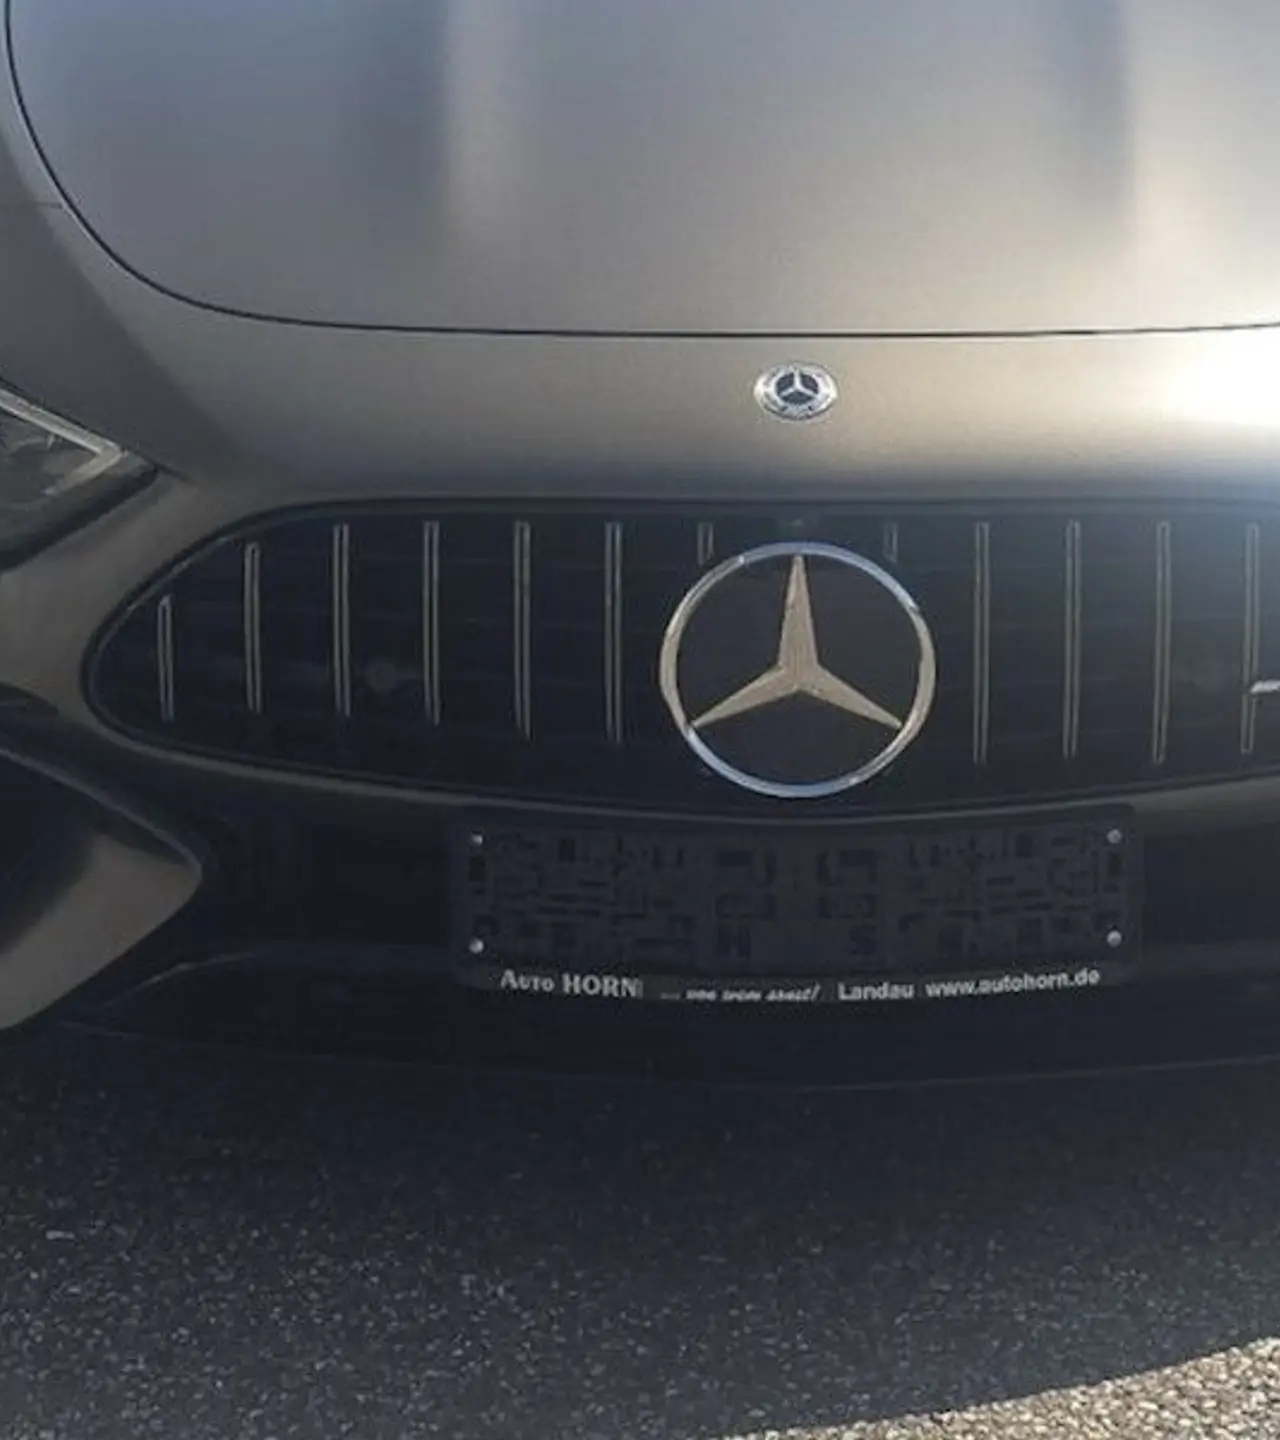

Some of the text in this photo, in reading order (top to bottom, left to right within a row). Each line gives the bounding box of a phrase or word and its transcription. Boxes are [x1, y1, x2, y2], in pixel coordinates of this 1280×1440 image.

[562, 973, 639, 998] HORN
[837, 981, 915, 1000] Landau
[925, 967, 1101, 998] www.autohorn.de
